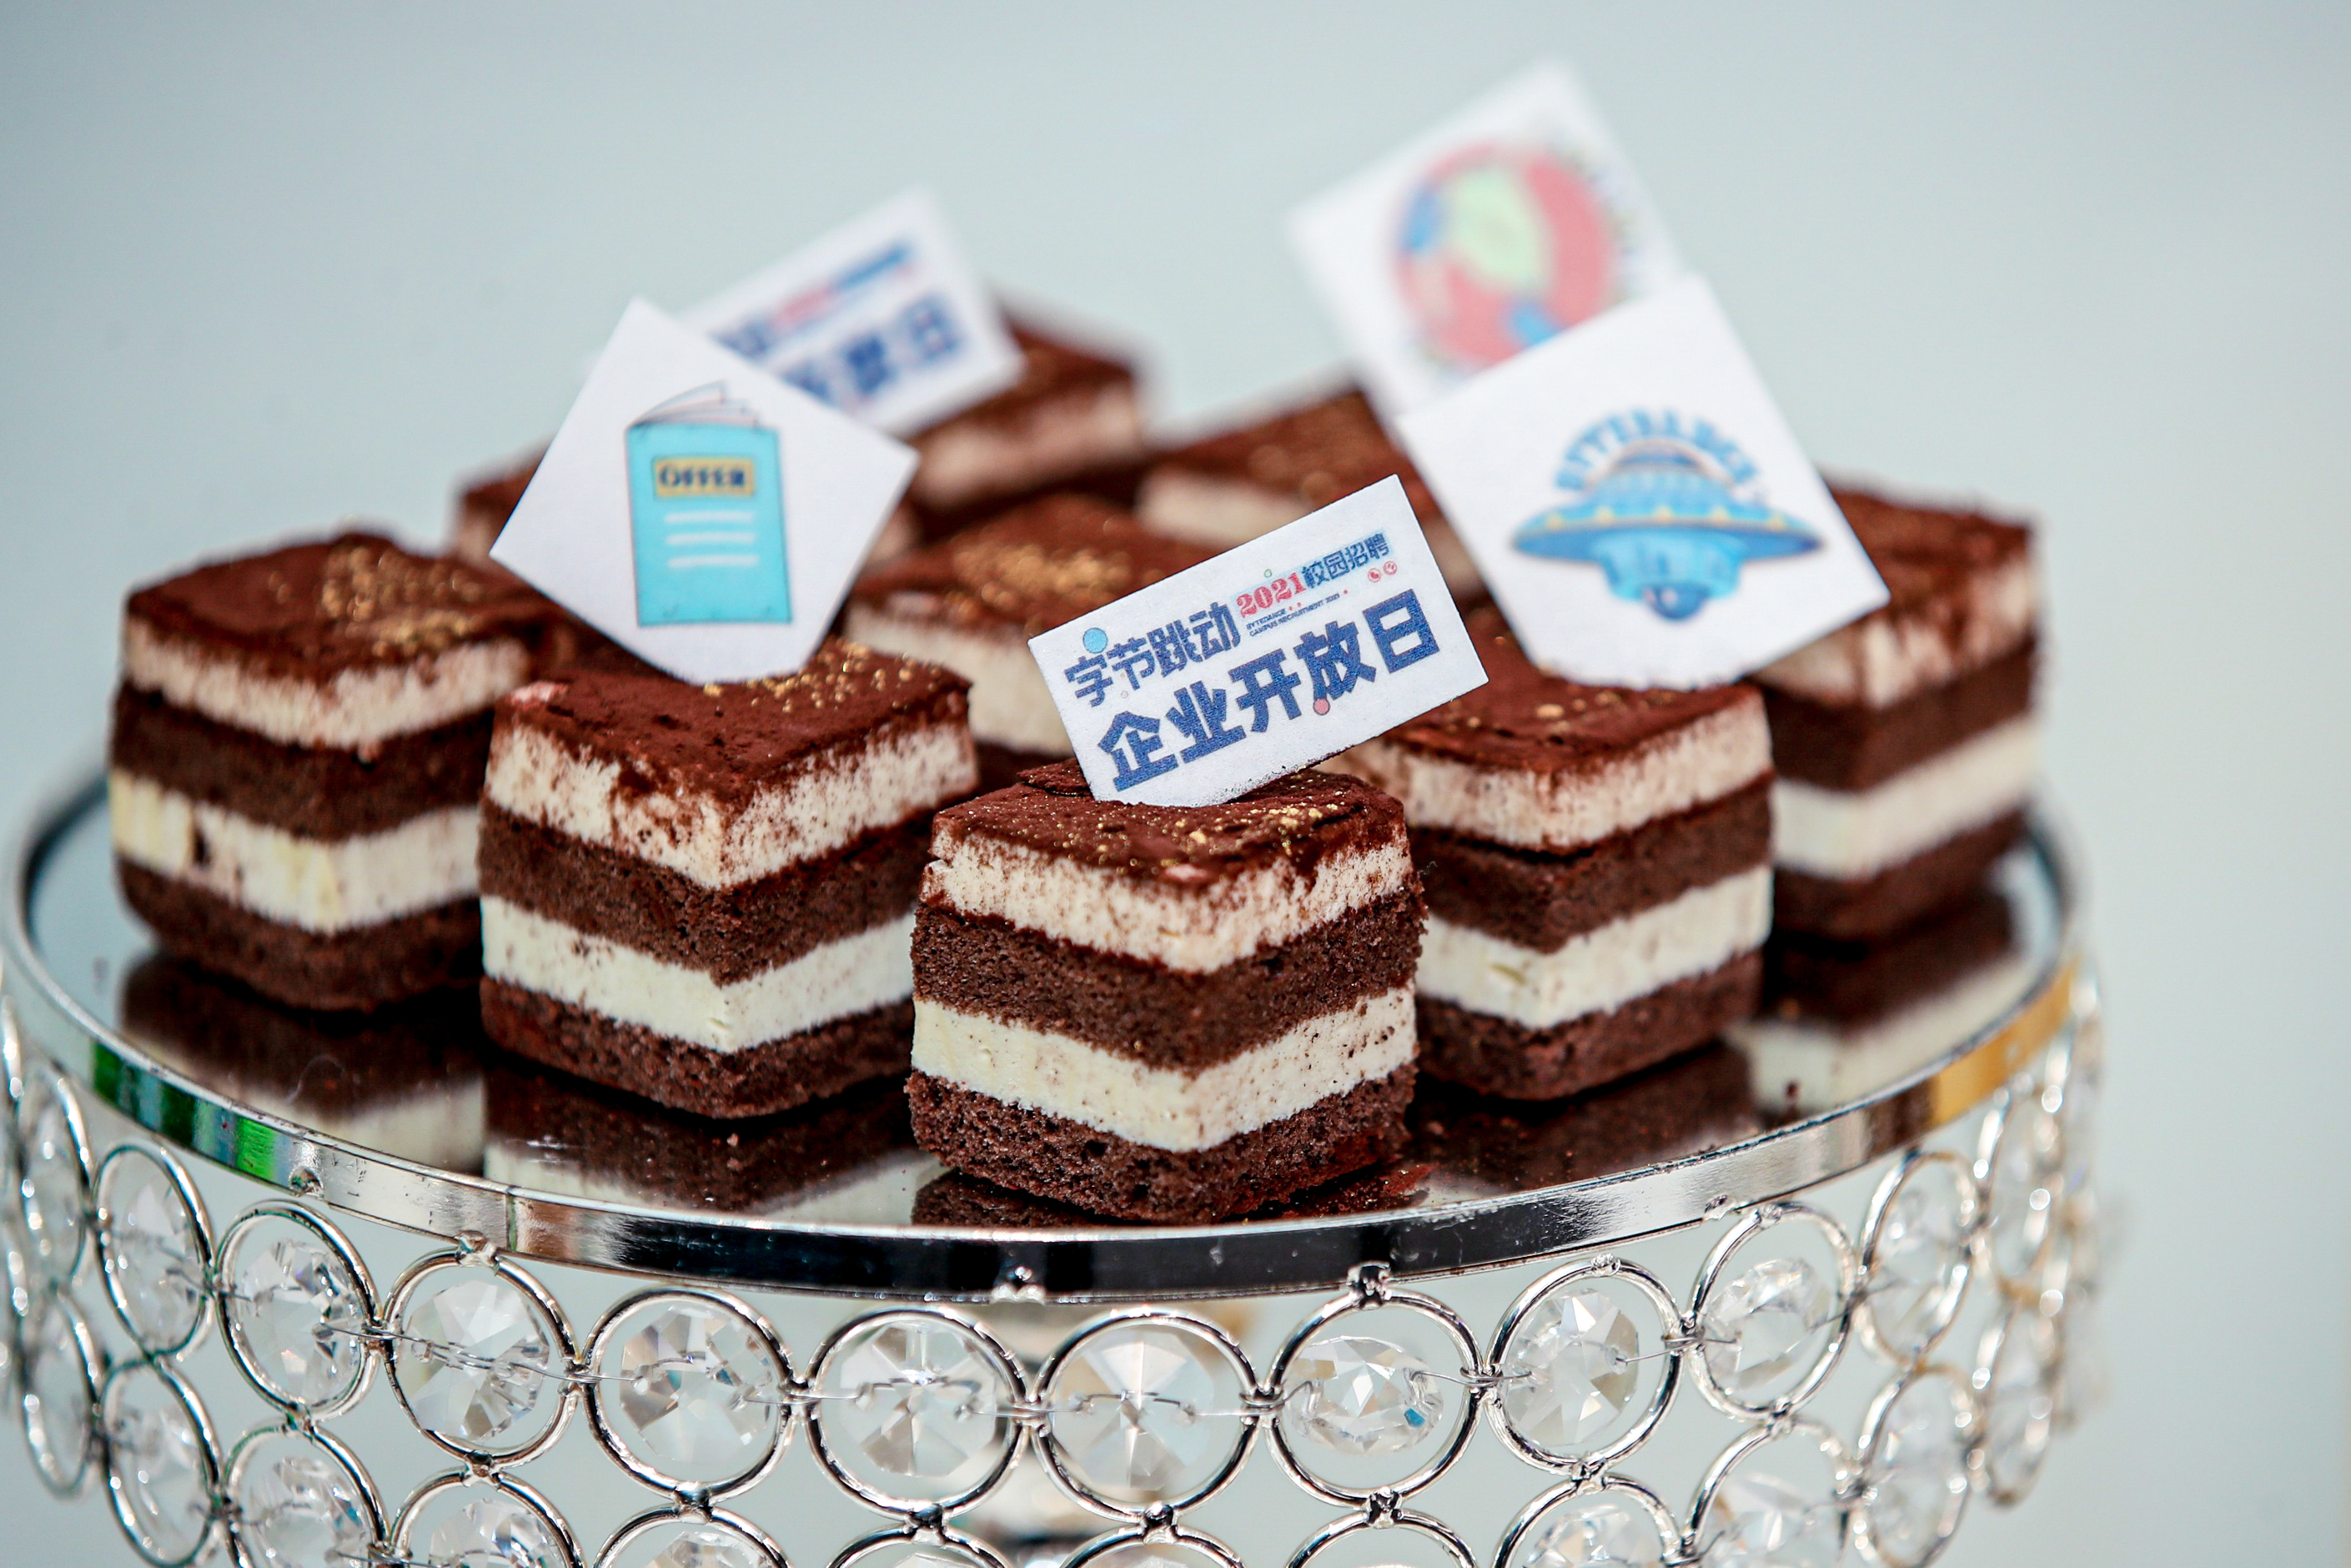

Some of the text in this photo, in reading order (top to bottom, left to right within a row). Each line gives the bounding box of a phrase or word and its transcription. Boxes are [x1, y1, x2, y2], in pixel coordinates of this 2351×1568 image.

[1064, 601, 1242, 708] 字节跳动
[1098, 588, 1439, 792] 企业开放日
